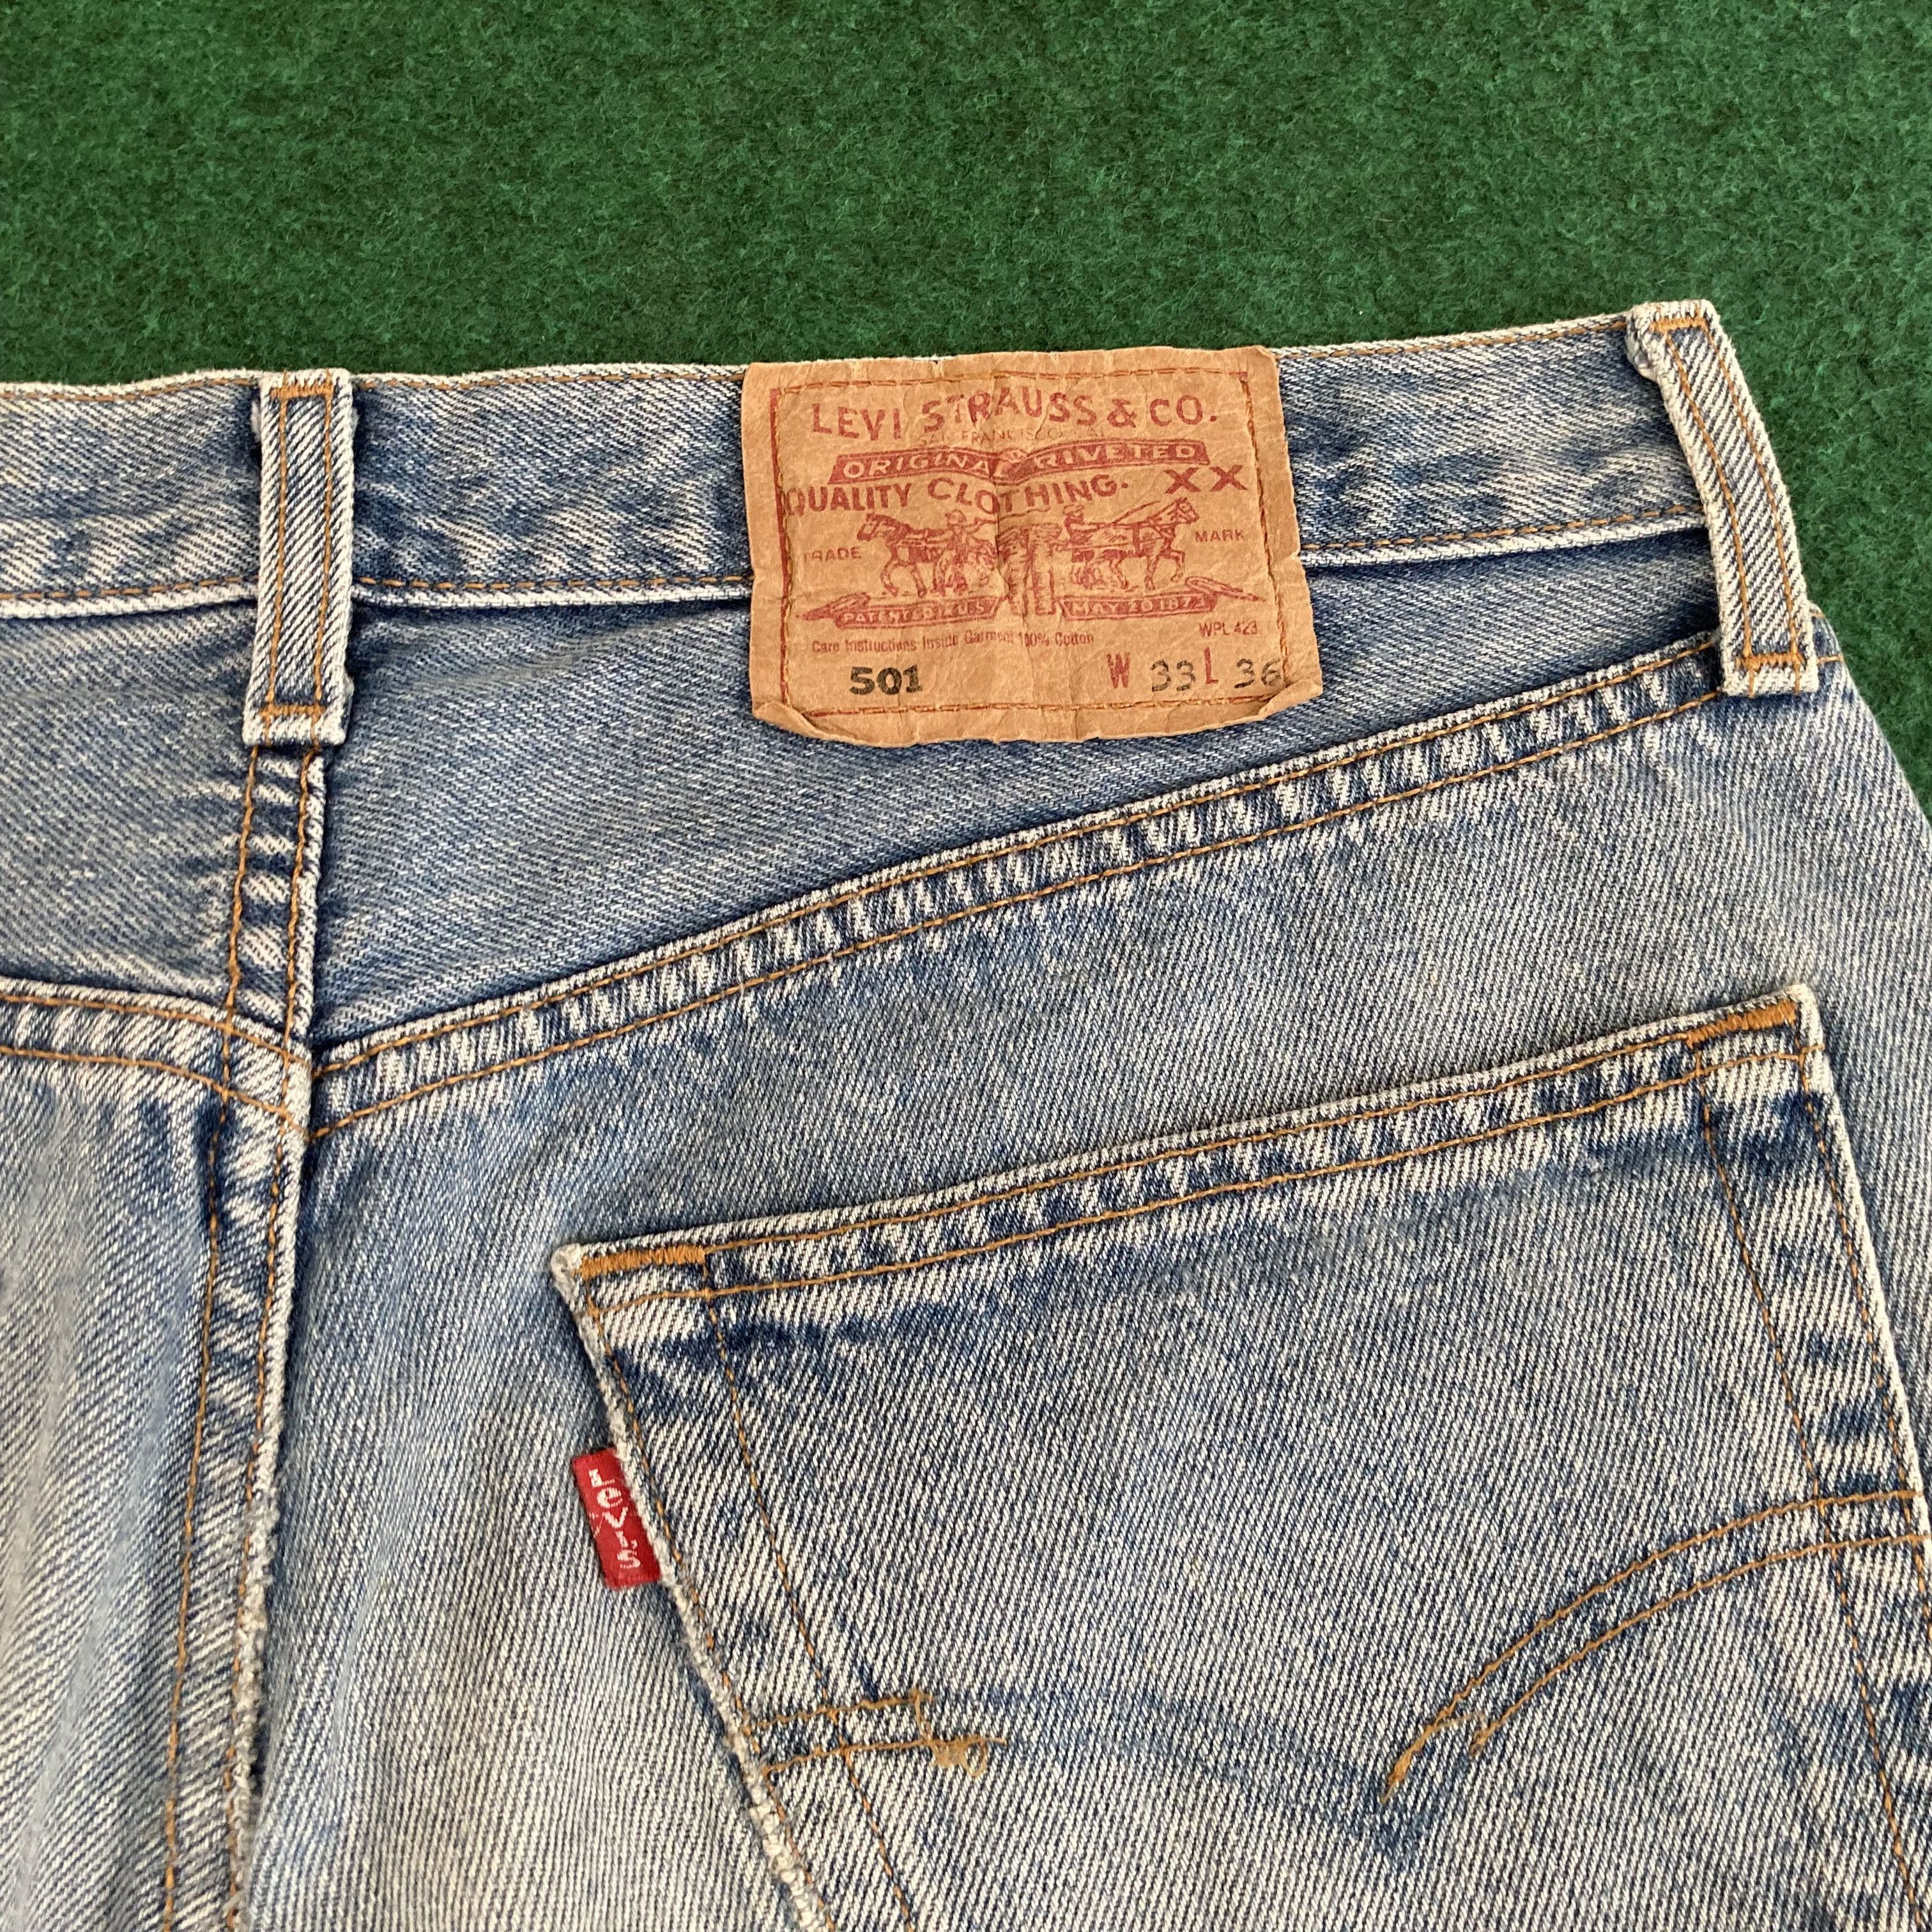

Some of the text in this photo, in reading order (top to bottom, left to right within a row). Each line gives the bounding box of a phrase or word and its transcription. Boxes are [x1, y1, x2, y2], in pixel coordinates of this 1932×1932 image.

[812, 386, 1218, 441] LEVI STRAUSS & CO.
[1032, 443, 1196, 470] RIVETED
[785, 482, 912, 516] QUALITY
[1194, 530, 1245, 543] MARK
[803, 547, 862, 564] TRADE
[1072, 601, 1118, 617] MAY
[1199, 620, 1258, 638] WPL 423
[811, 640, 840, 653] Care
[849, 664, 923, 696] 501
[1106, 647, 1282, 693] W 33 L 36
